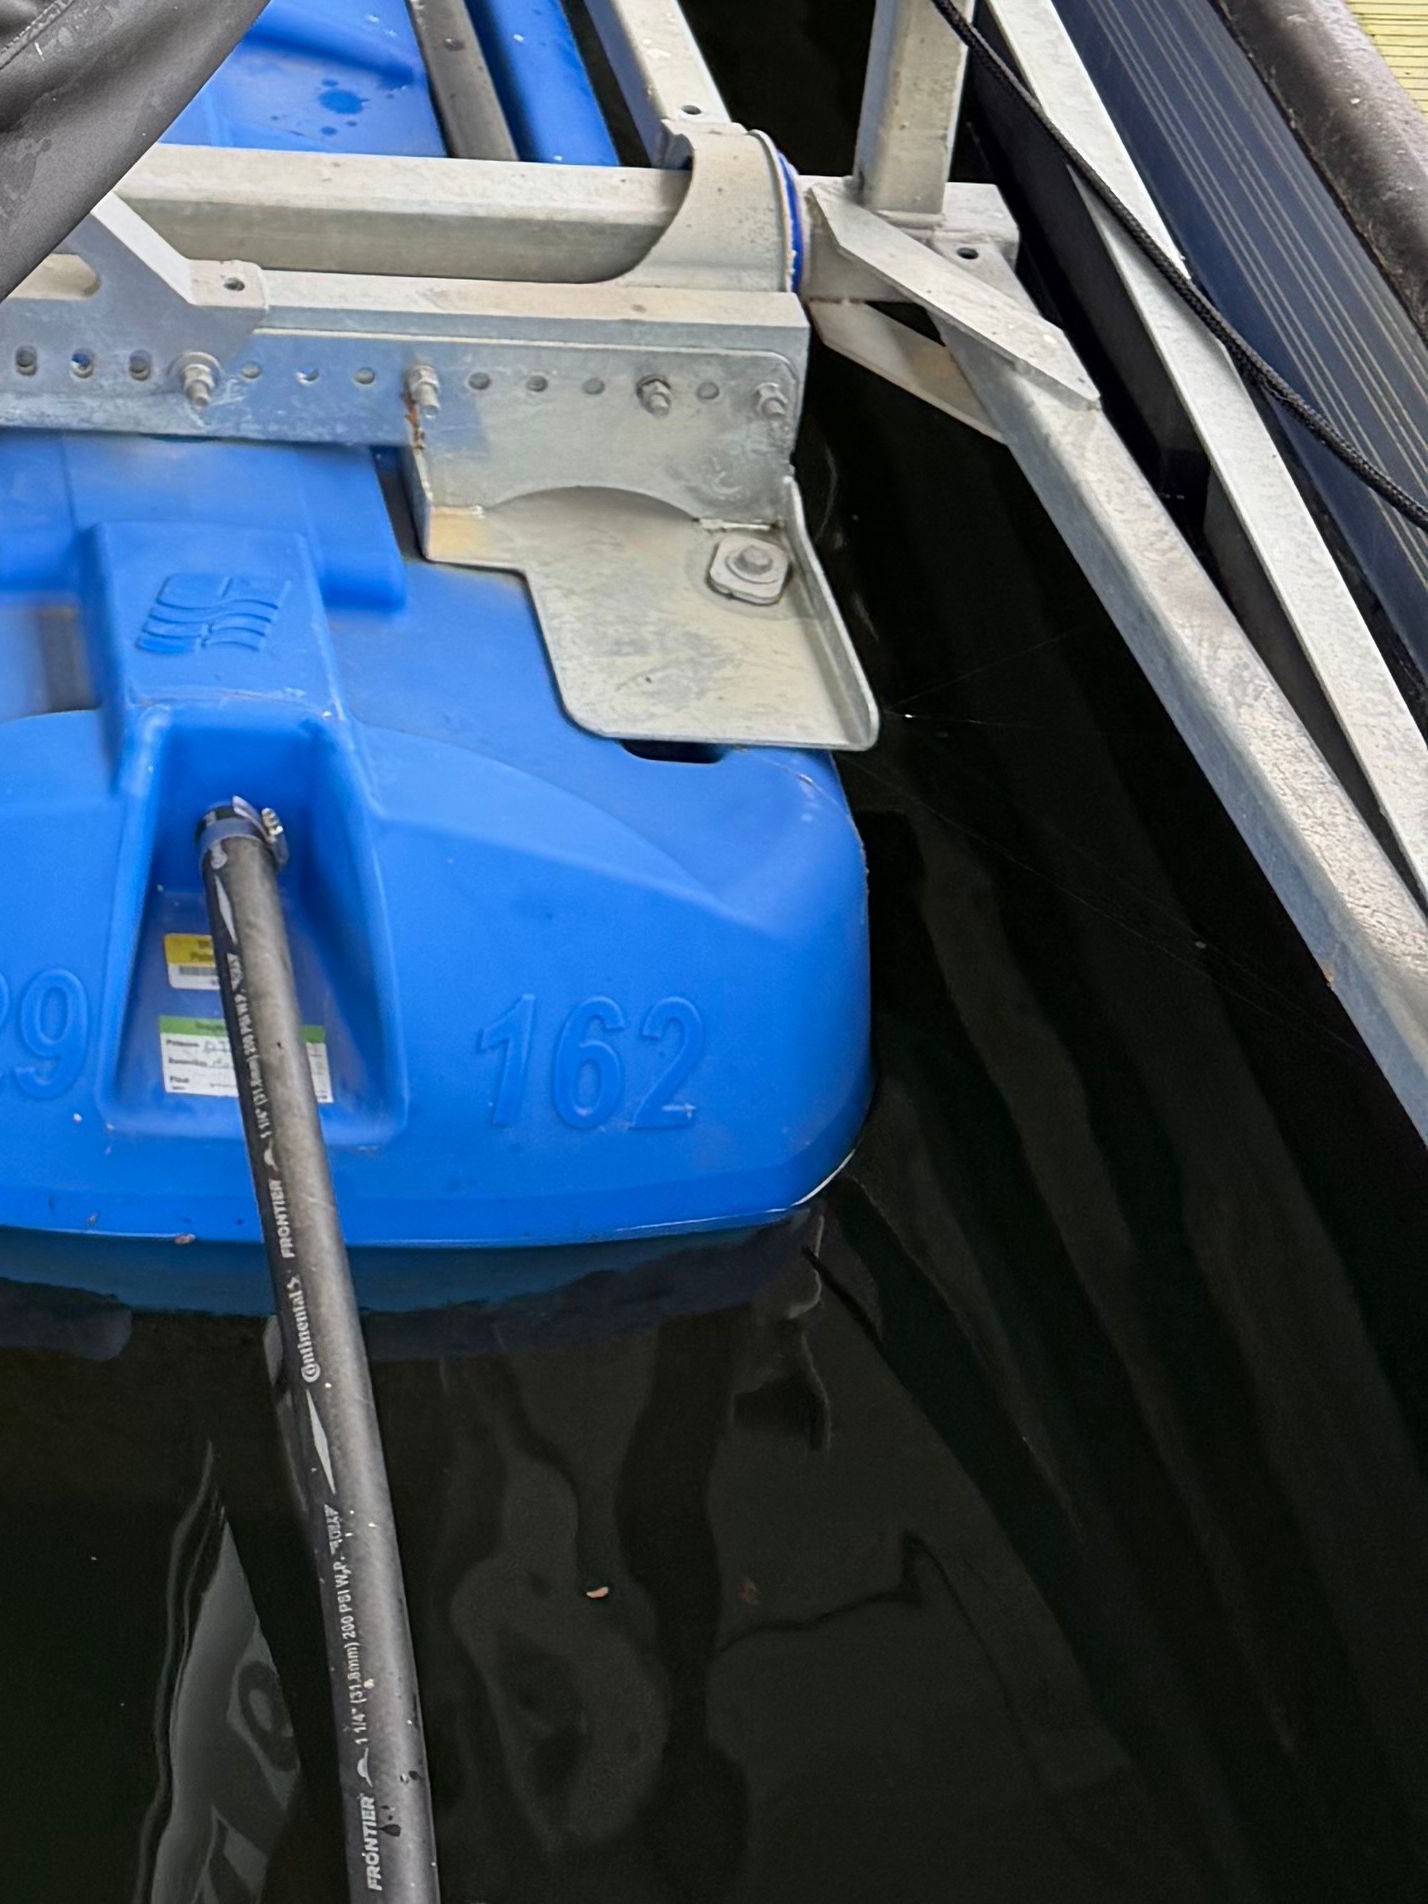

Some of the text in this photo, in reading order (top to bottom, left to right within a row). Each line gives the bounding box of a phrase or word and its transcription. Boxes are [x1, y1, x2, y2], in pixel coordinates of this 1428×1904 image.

[476, 993, 704, 1130] 162
[269, 1178, 296, 1258] FRONTIER
[337, 1589, 352, 1612] PSI
[340, 1615, 356, 1639] 200
[359, 1795, 383, 1891] FRONTIER
